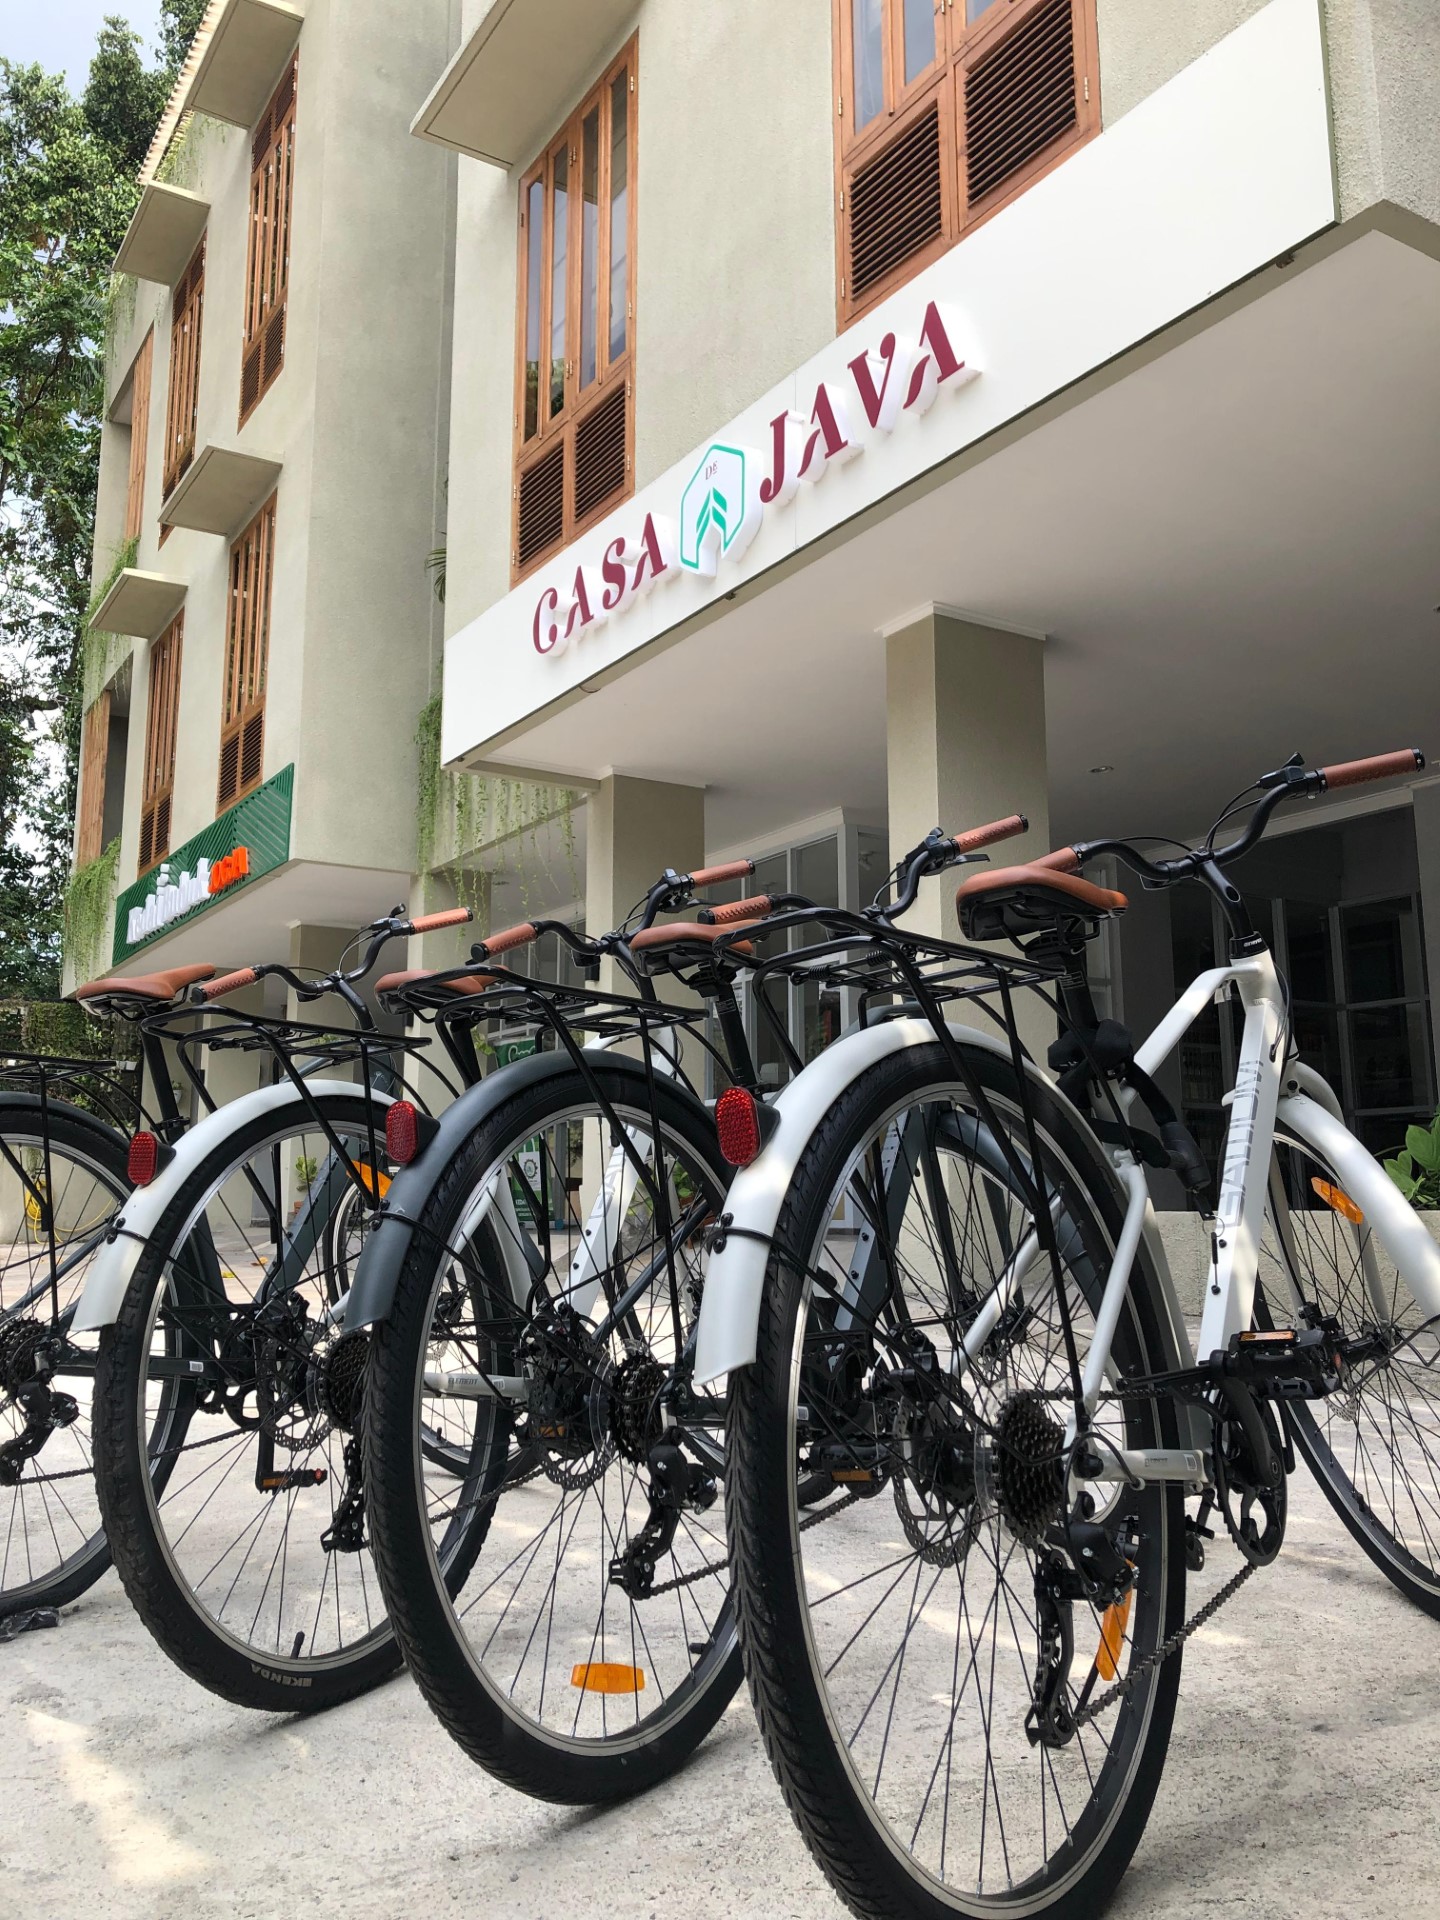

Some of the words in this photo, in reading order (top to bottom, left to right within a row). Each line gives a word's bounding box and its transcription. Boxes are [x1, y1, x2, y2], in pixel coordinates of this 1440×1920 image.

[532, 511, 668, 655] CASA
[759, 300, 966, 504] JAVA
[252, 1664, 305, 1687] KENDA
